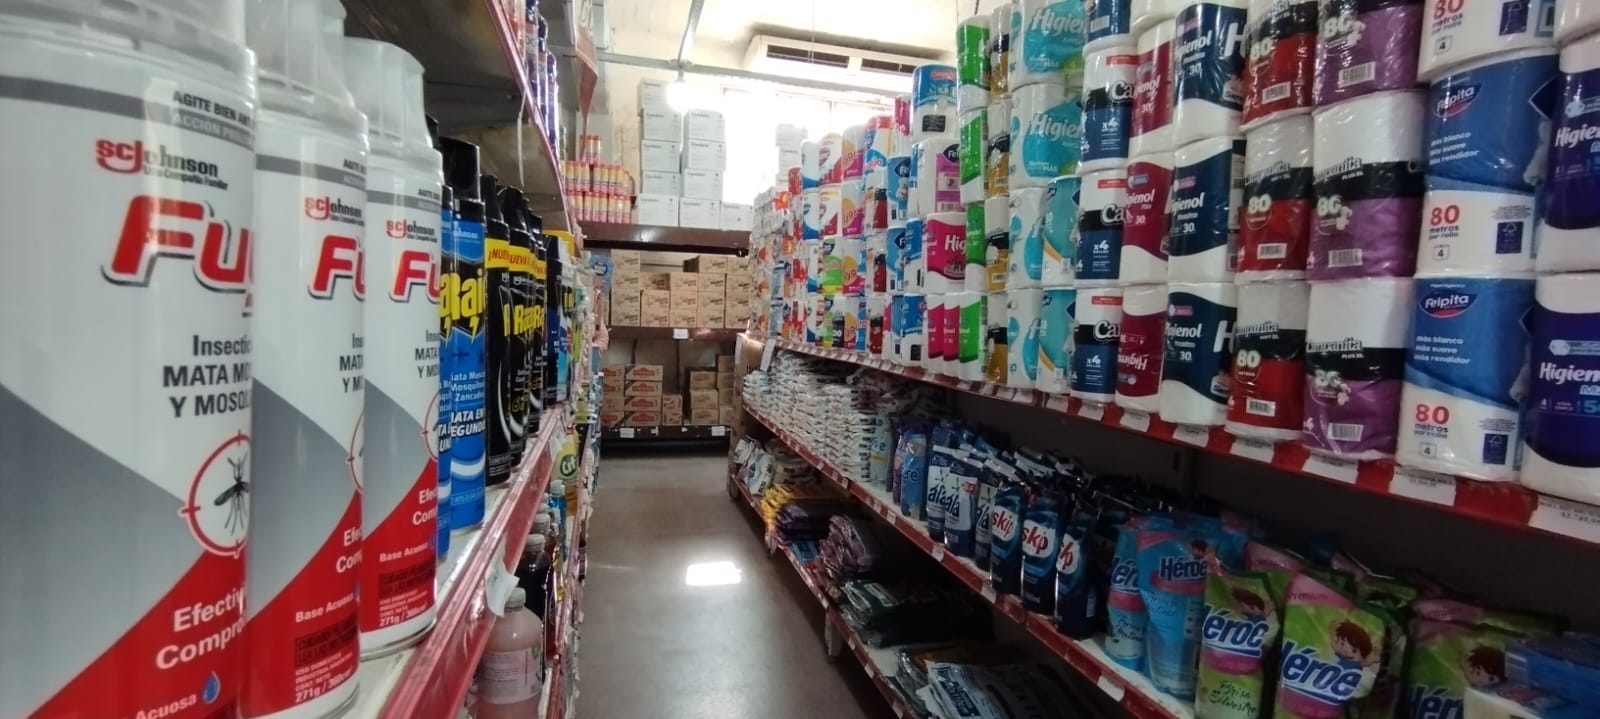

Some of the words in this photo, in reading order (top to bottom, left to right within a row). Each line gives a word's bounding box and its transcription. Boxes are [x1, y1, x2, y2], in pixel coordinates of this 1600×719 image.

[214, 102, 236, 121] BIEN
[1248, 194, 1272, 215] 80
[1430, 205, 1460, 226] 80
[1183, 222, 1195, 233] 30
[1429, 224, 1459, 234] metros
[1093, 239, 1109, 250] x4
[1437, 249, 1444, 258] 4
[1425, 294, 1469, 310] Felpita
[1086, 354, 1102, 364] x4
[1180, 351, 1191, 361] 30
[1236, 349, 1261, 368] 80
[163, 364, 229, 387] MATA
[168, 396, 187, 418] Y
[1416, 404, 1449, 425] 80
[1424, 446, 1431, 455] 4
[295, 607, 324, 623] Base
